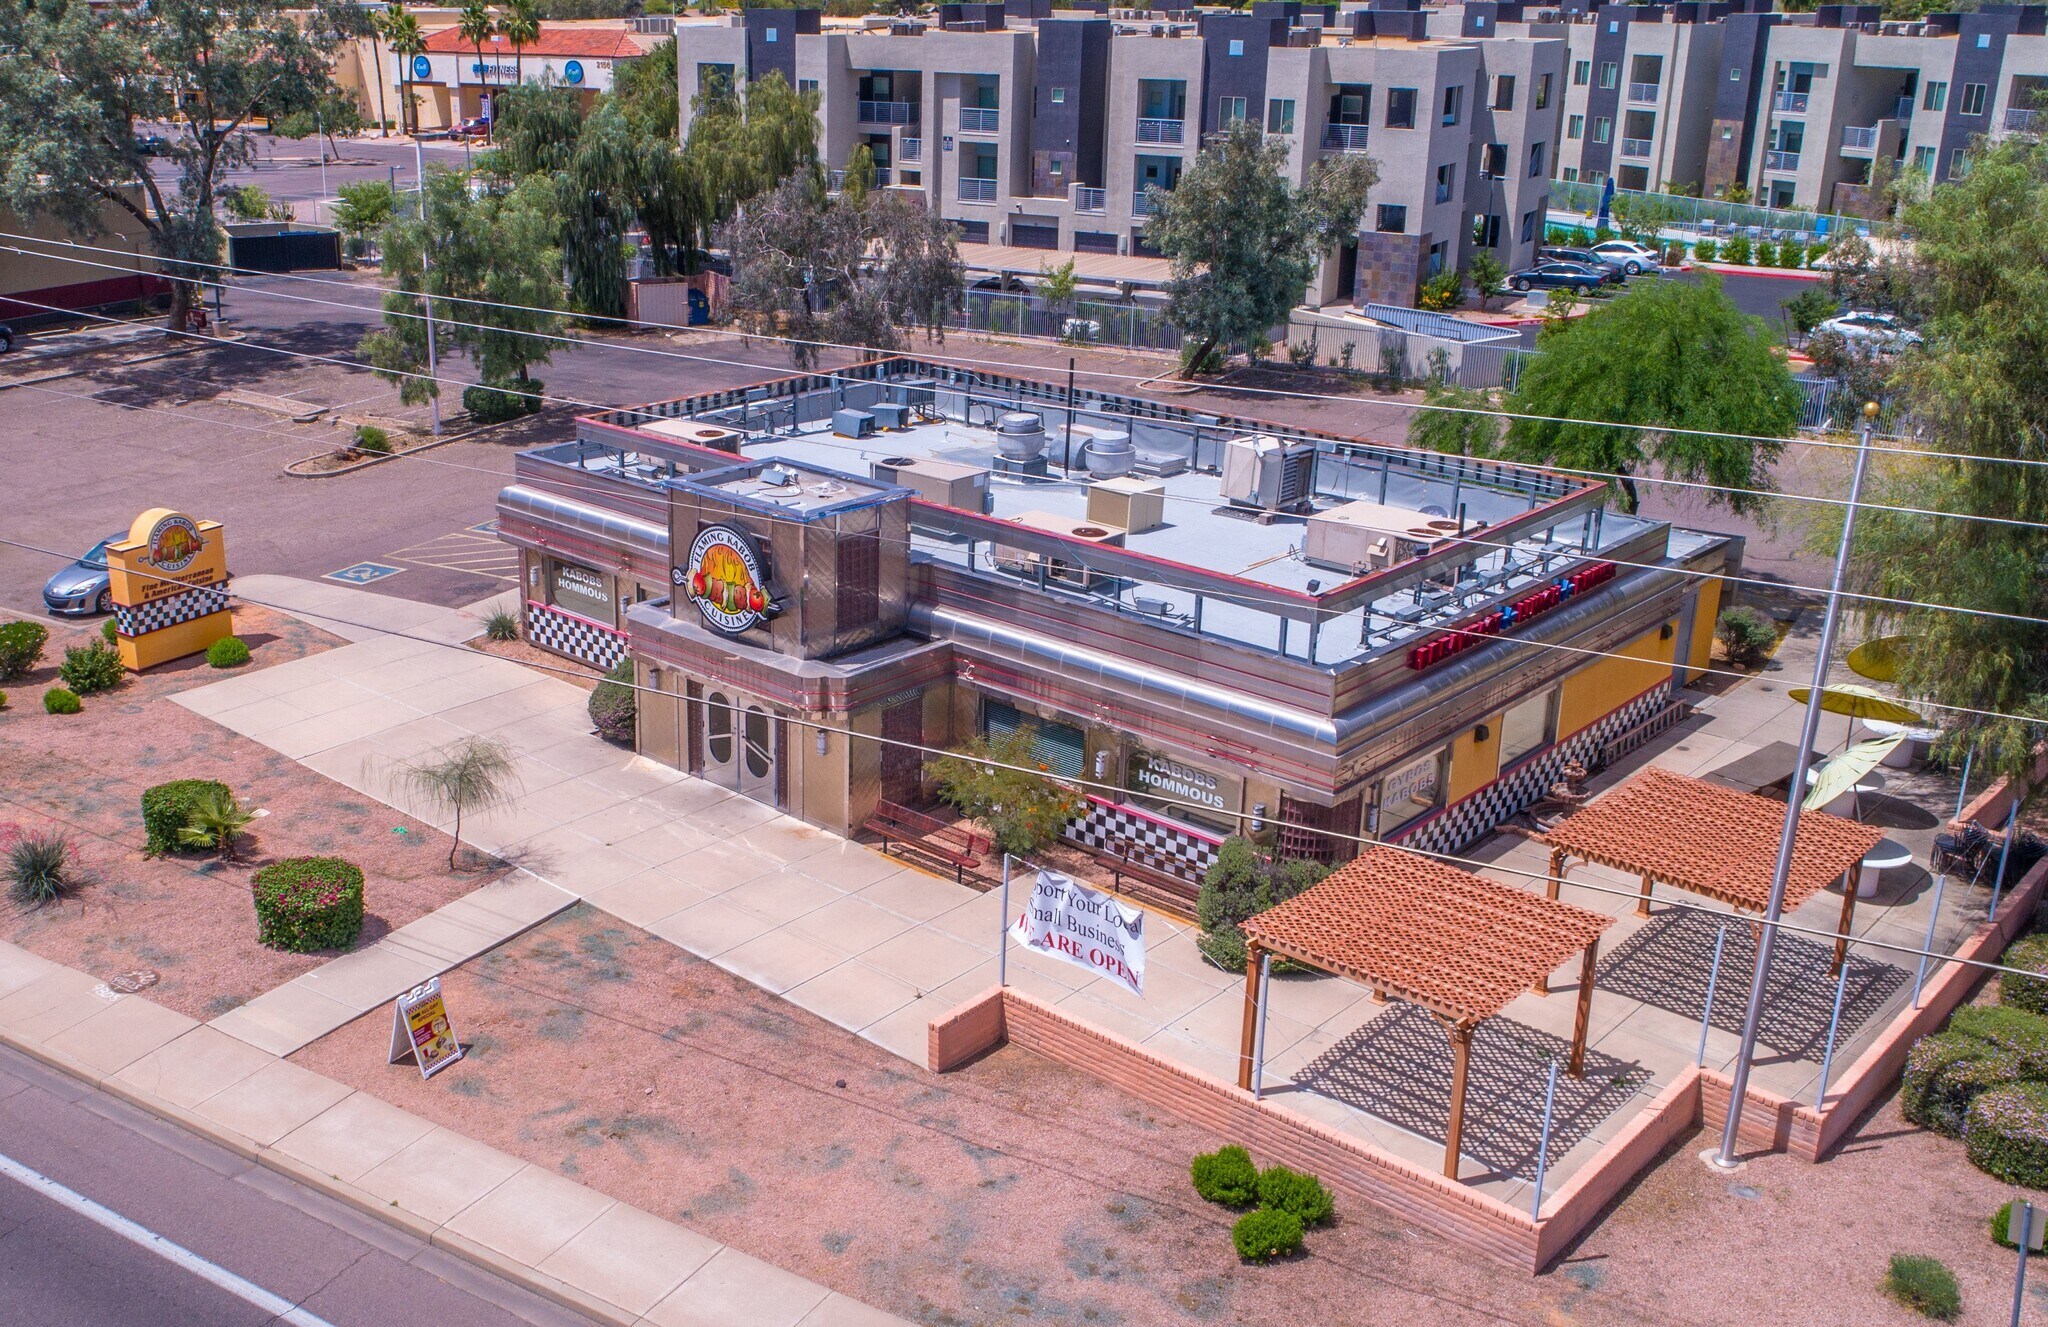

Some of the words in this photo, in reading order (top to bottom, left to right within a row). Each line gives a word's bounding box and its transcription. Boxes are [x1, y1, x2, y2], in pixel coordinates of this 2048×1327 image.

[174, 519, 193, 532] KABOB
[694, 533, 724, 564] FLAMING
[727, 535, 756, 572] KABOB
[558, 577, 608, 602] HOMMOUS
[562, 566, 603, 588] KABOBS
[703, 600, 750, 626] CUISINE
[1138, 768, 1225, 809] HOMMOUS
[1148, 757, 1218, 790] KABOBS
[1388, 760, 1432, 790] GYROS
[1383, 773, 1436, 809] KABOBS
[1034, 882, 1066, 901] port
[1067, 889, 1101, 916] Your
[1067, 914, 1125, 956] Business
[1040, 931, 1083, 959] ARE
[1089, 948, 1140, 987] OPEN
